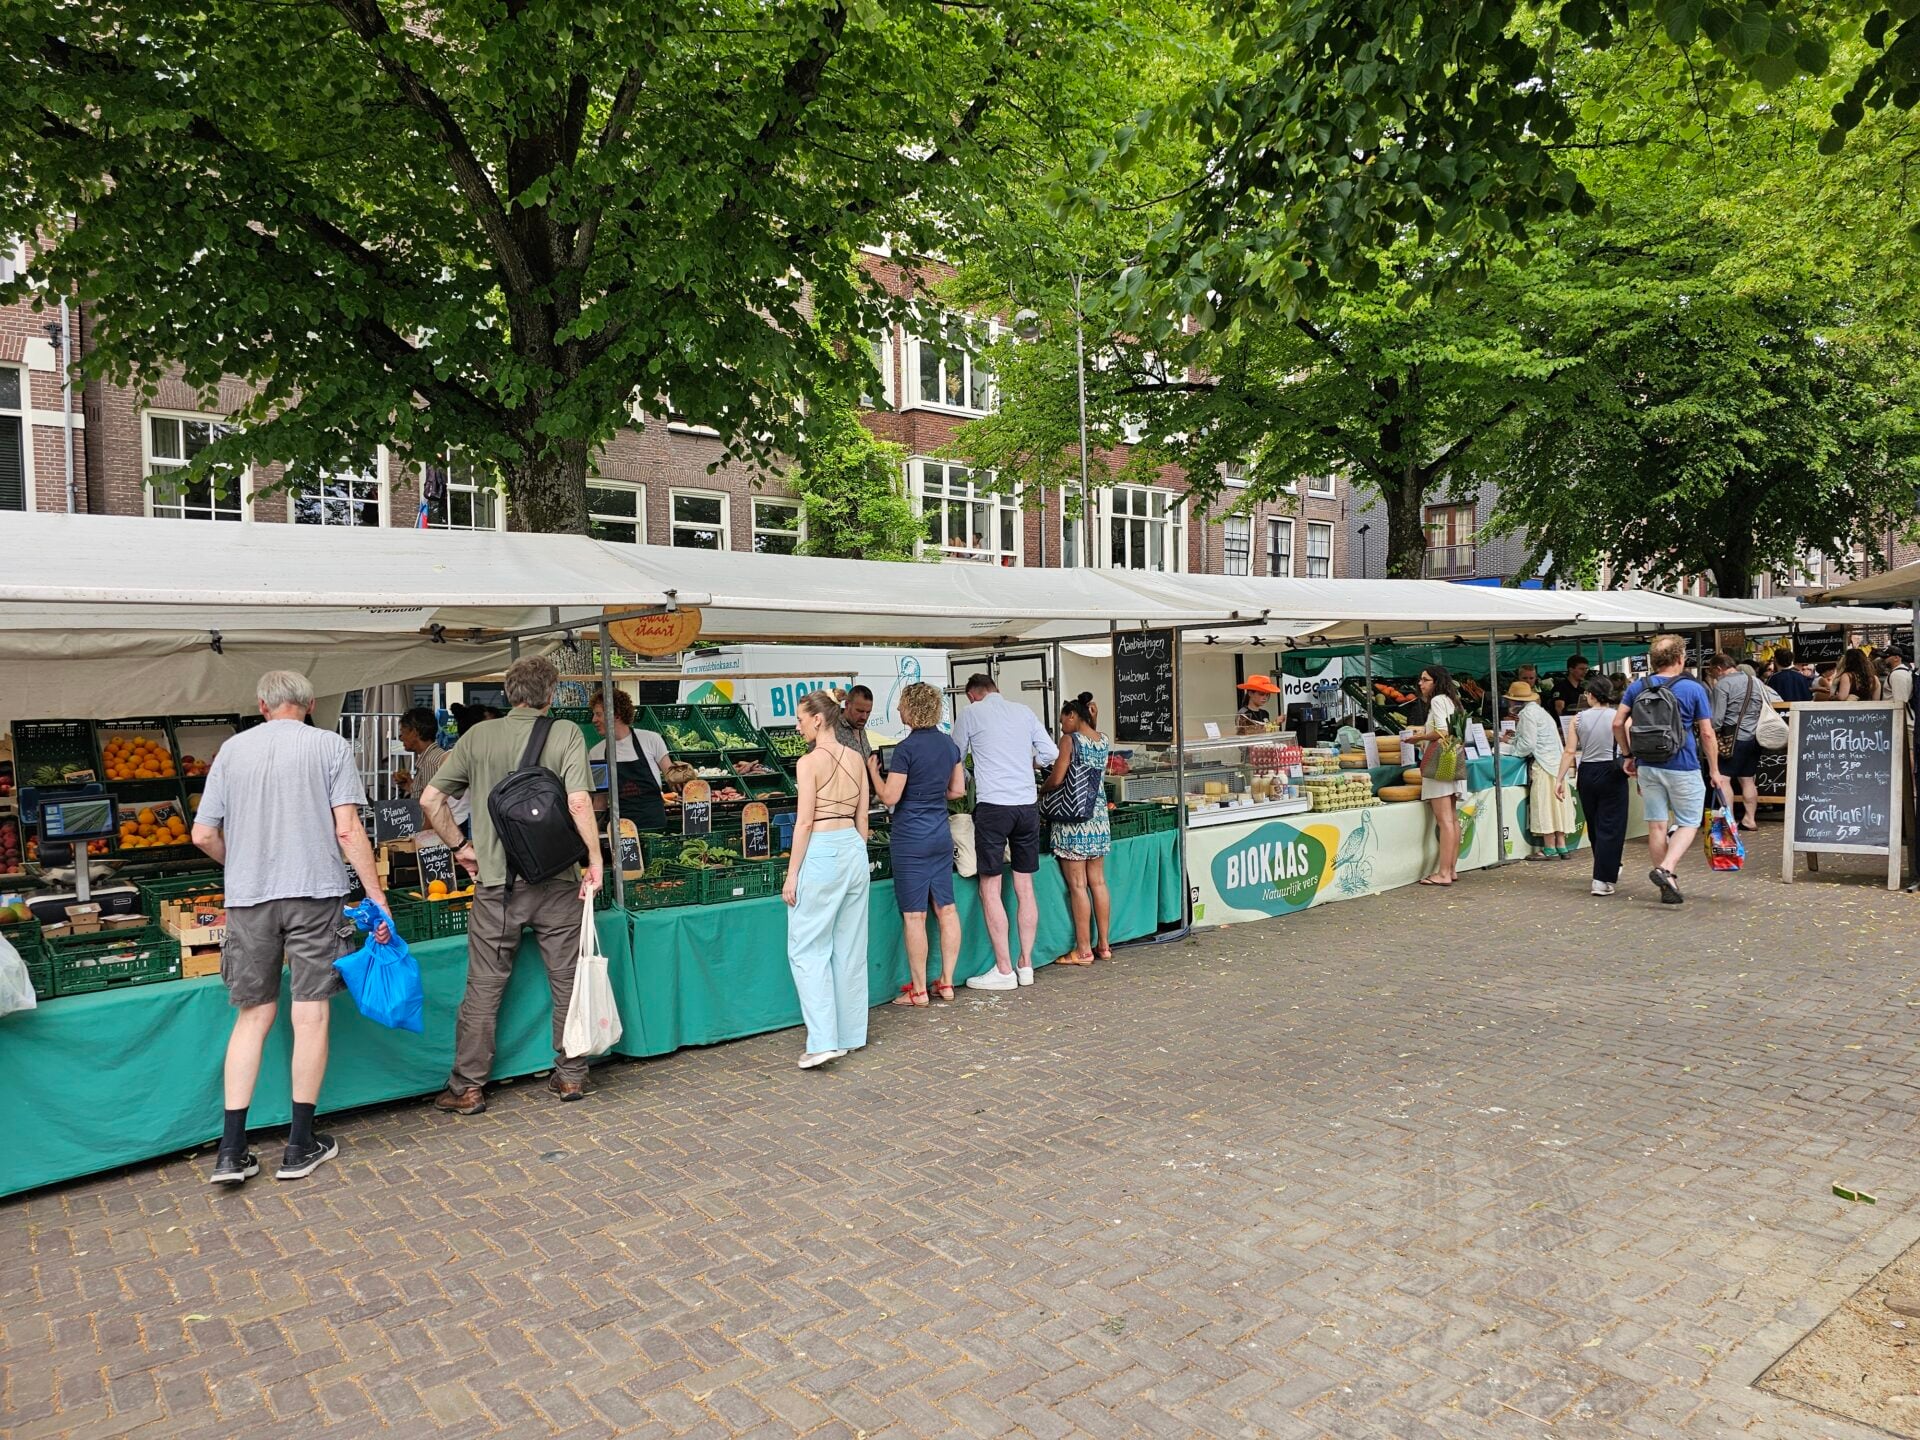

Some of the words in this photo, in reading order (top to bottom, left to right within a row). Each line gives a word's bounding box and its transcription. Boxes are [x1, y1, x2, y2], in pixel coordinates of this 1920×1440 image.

[635, 624, 675, 637] staart
[1118, 636, 1165, 659] Aanbiedingen
[1830, 728, 1890, 752] Portabella
[1226, 841, 1309, 890] BIOKAAS
[1262, 880, 1301, 901] Natuurlijk
[1302, 875, 1319, 890] vers
